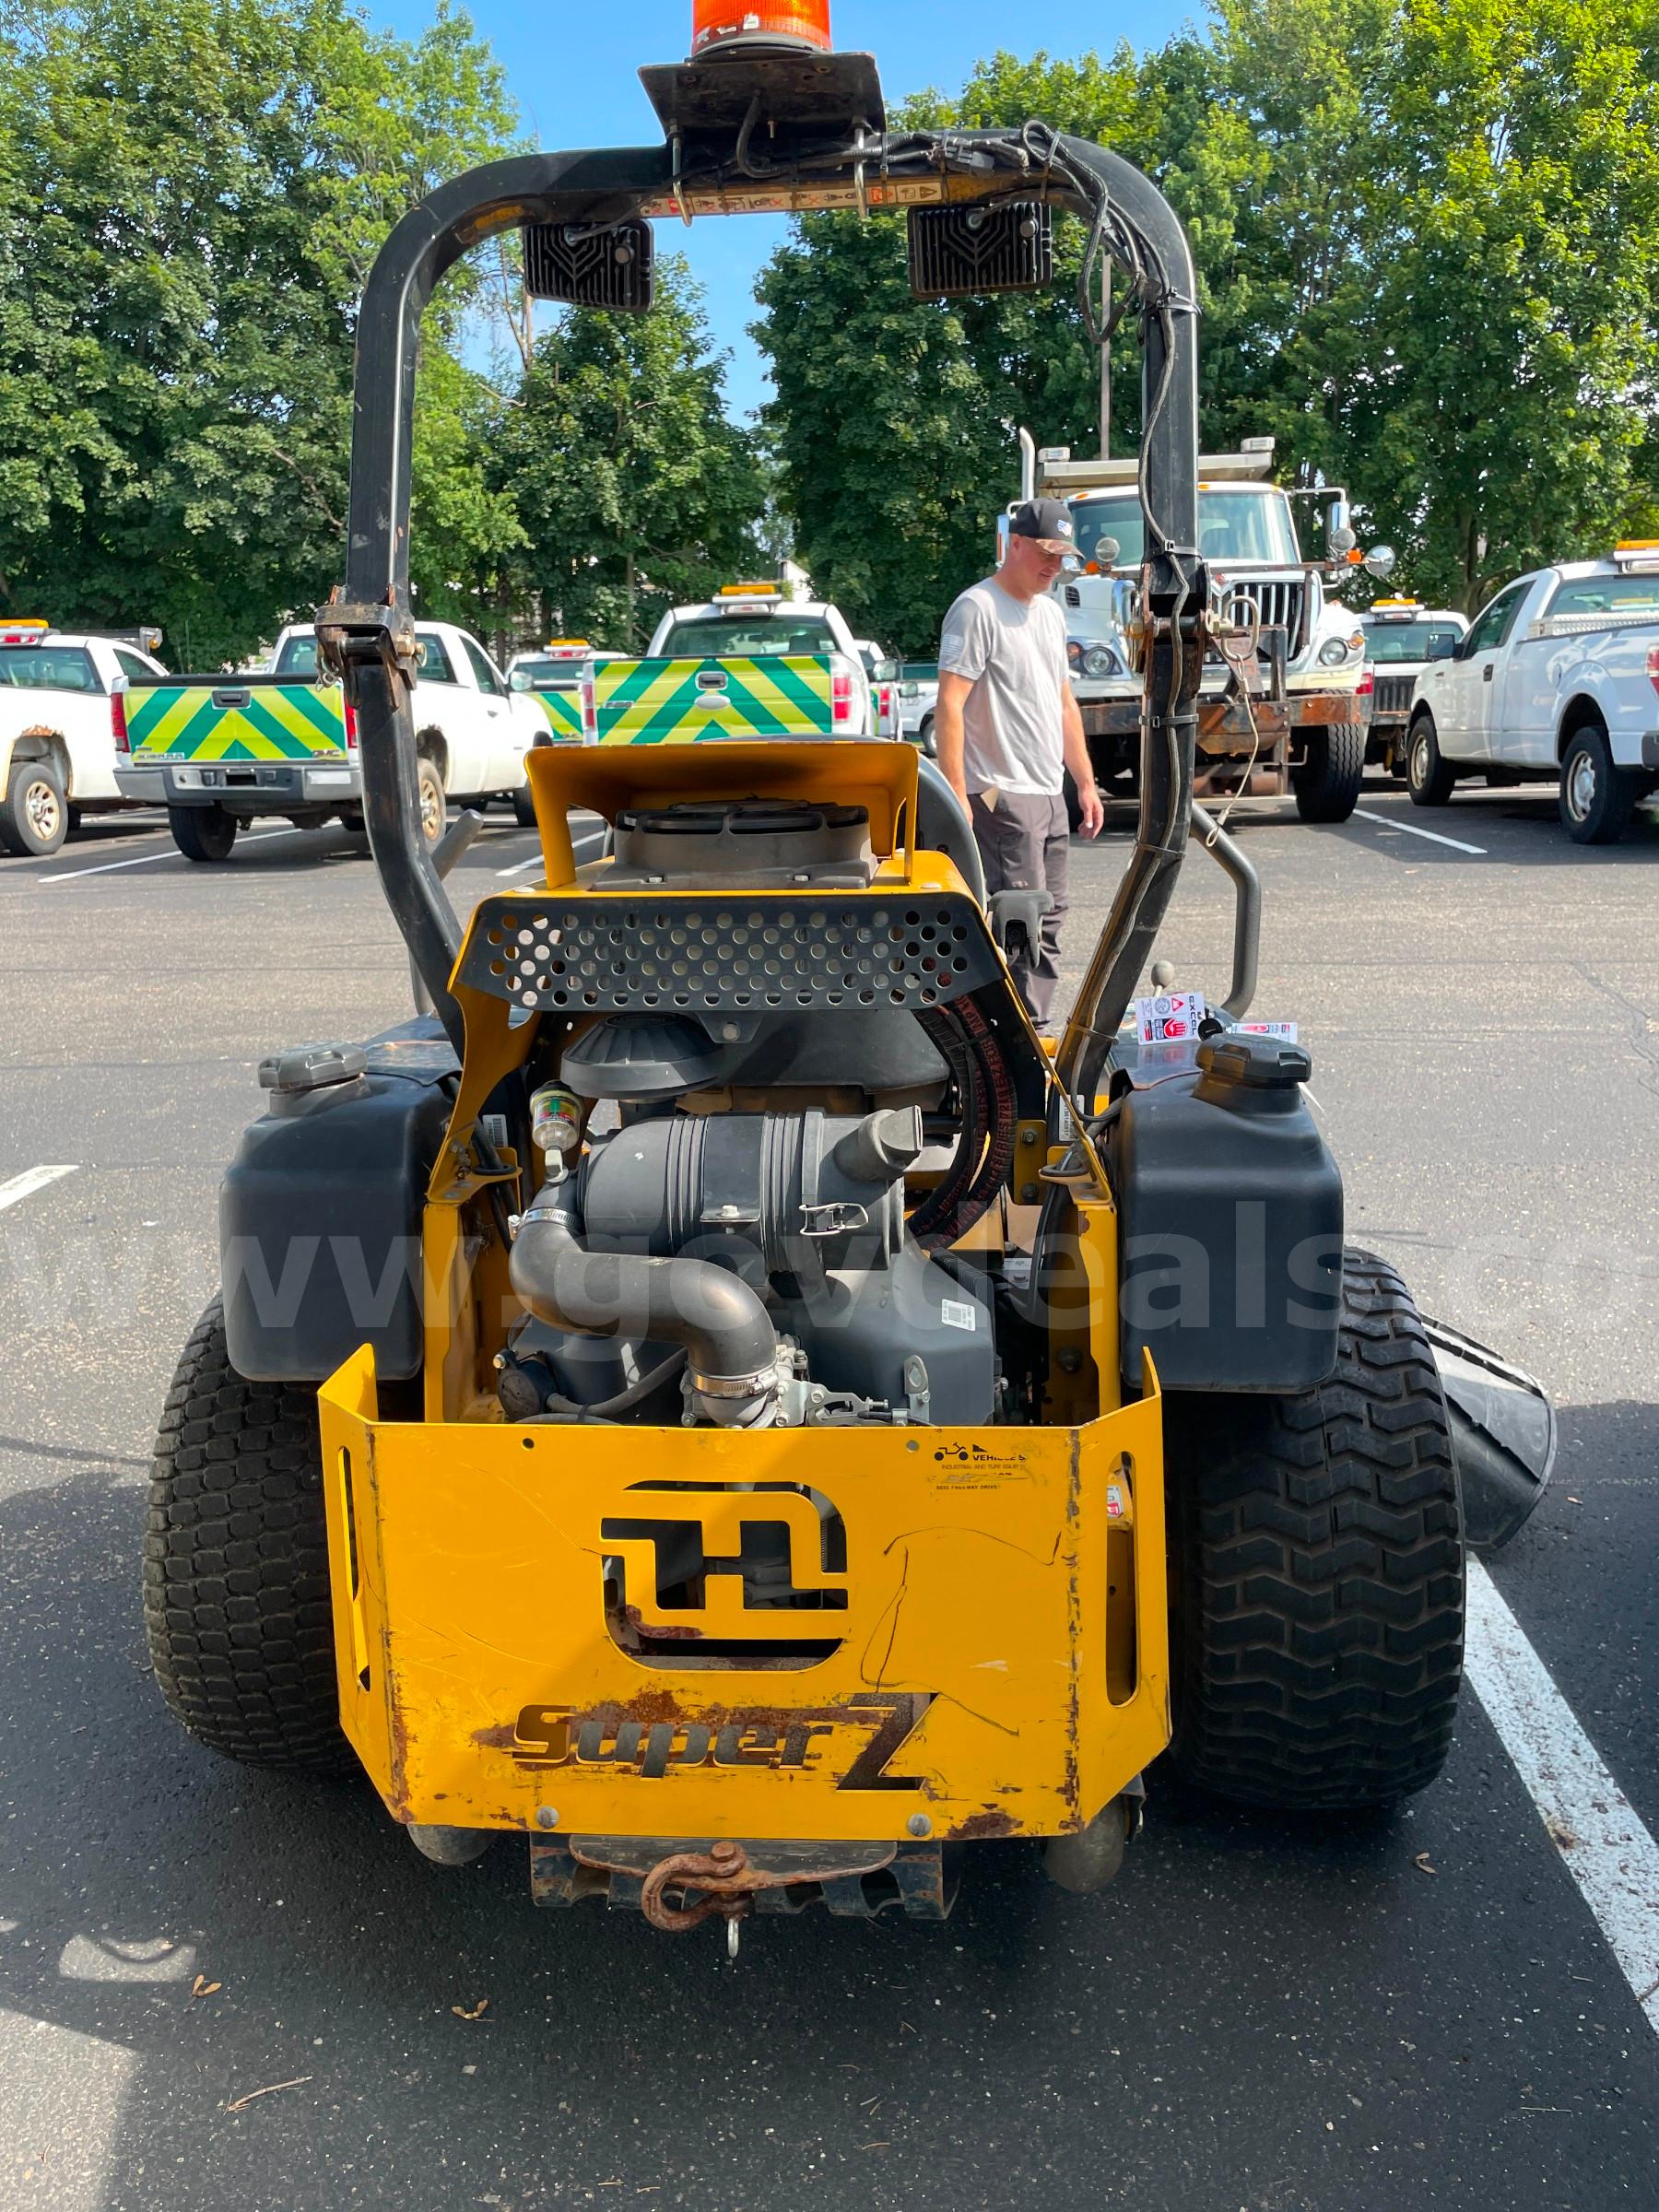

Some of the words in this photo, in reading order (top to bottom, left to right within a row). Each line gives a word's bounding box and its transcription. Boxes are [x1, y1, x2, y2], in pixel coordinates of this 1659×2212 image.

[1188, 995, 1197, 1036] EXCEL
[512, 1703, 833, 1780] Super
[835, 1690, 940, 1792] Z
